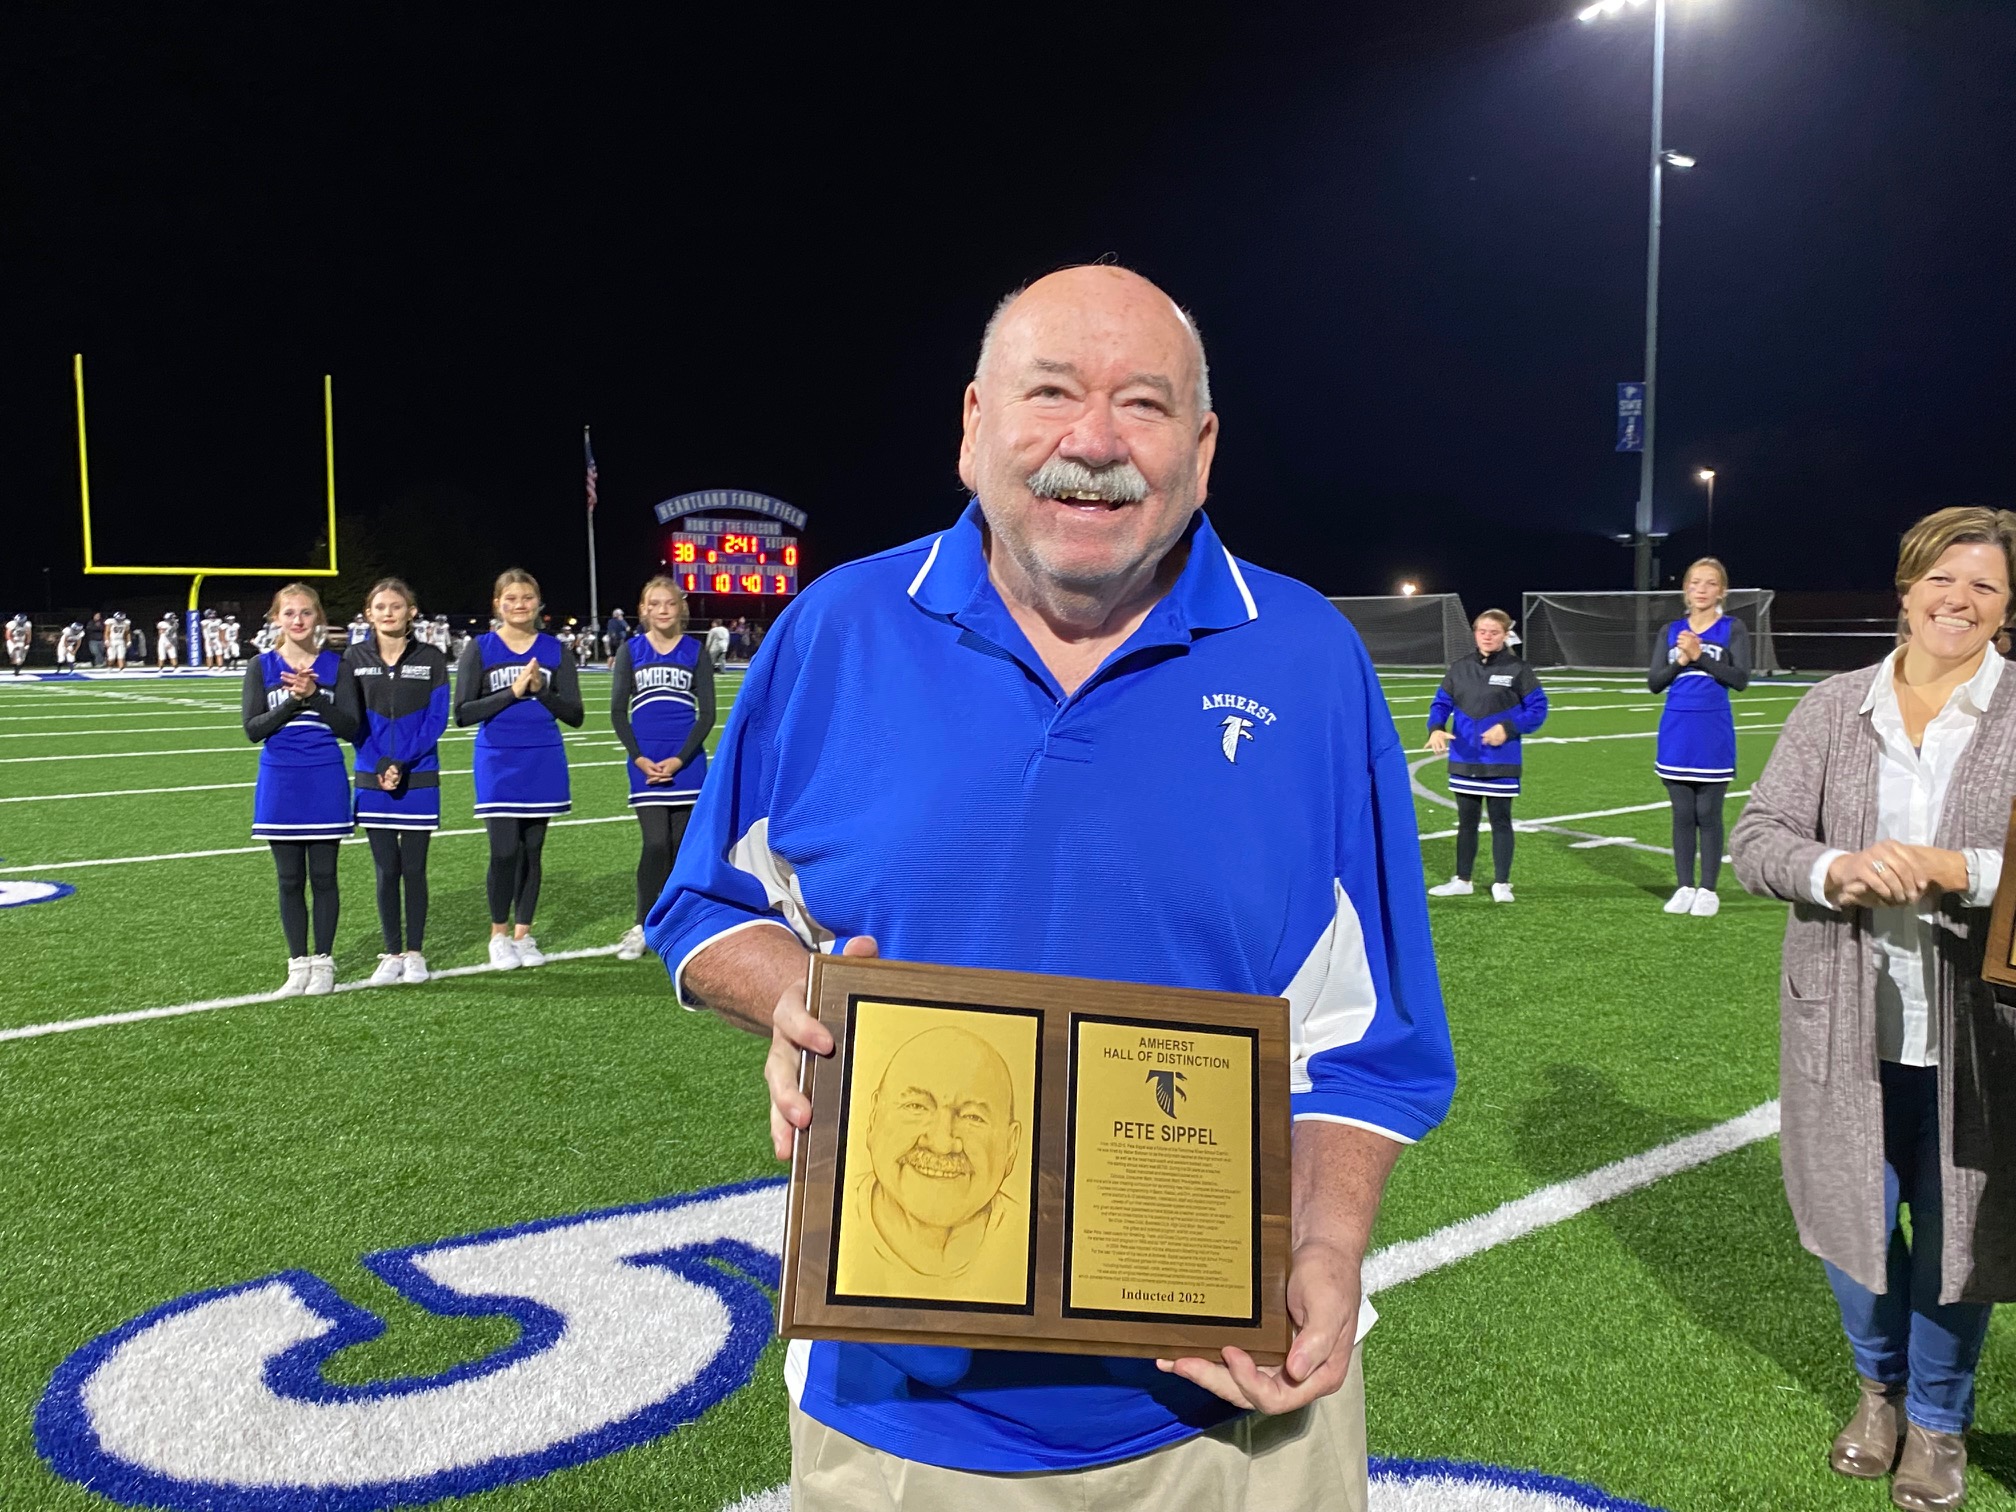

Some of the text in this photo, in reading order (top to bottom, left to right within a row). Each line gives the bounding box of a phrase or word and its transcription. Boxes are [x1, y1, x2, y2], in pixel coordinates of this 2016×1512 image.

[659, 492, 804, 526] HEARTLAND FARMS FIELD
[712, 520, 723, 532] OF
[726, 520, 740, 533] THE
[674, 542, 695, 562] 38
[725, 534, 757, 553] 2:41
[785, 546, 797, 566] 0
[715, 573, 730, 593] 10
[742, 574, 762, 593] 40
[775, 574, 786, 594] 3
[635, 666, 693, 691] AMHERST
[1202, 693, 1277, 725] AMHERST
[1139, 1037, 1195, 1052] AMHERST
[1103, 1047, 1230, 1069] HALL OF DISTINCTION
[1113, 1120, 1218, 1146] PETE SIPPEL
[1121, 1287, 1206, 1304] Inducted 2022
